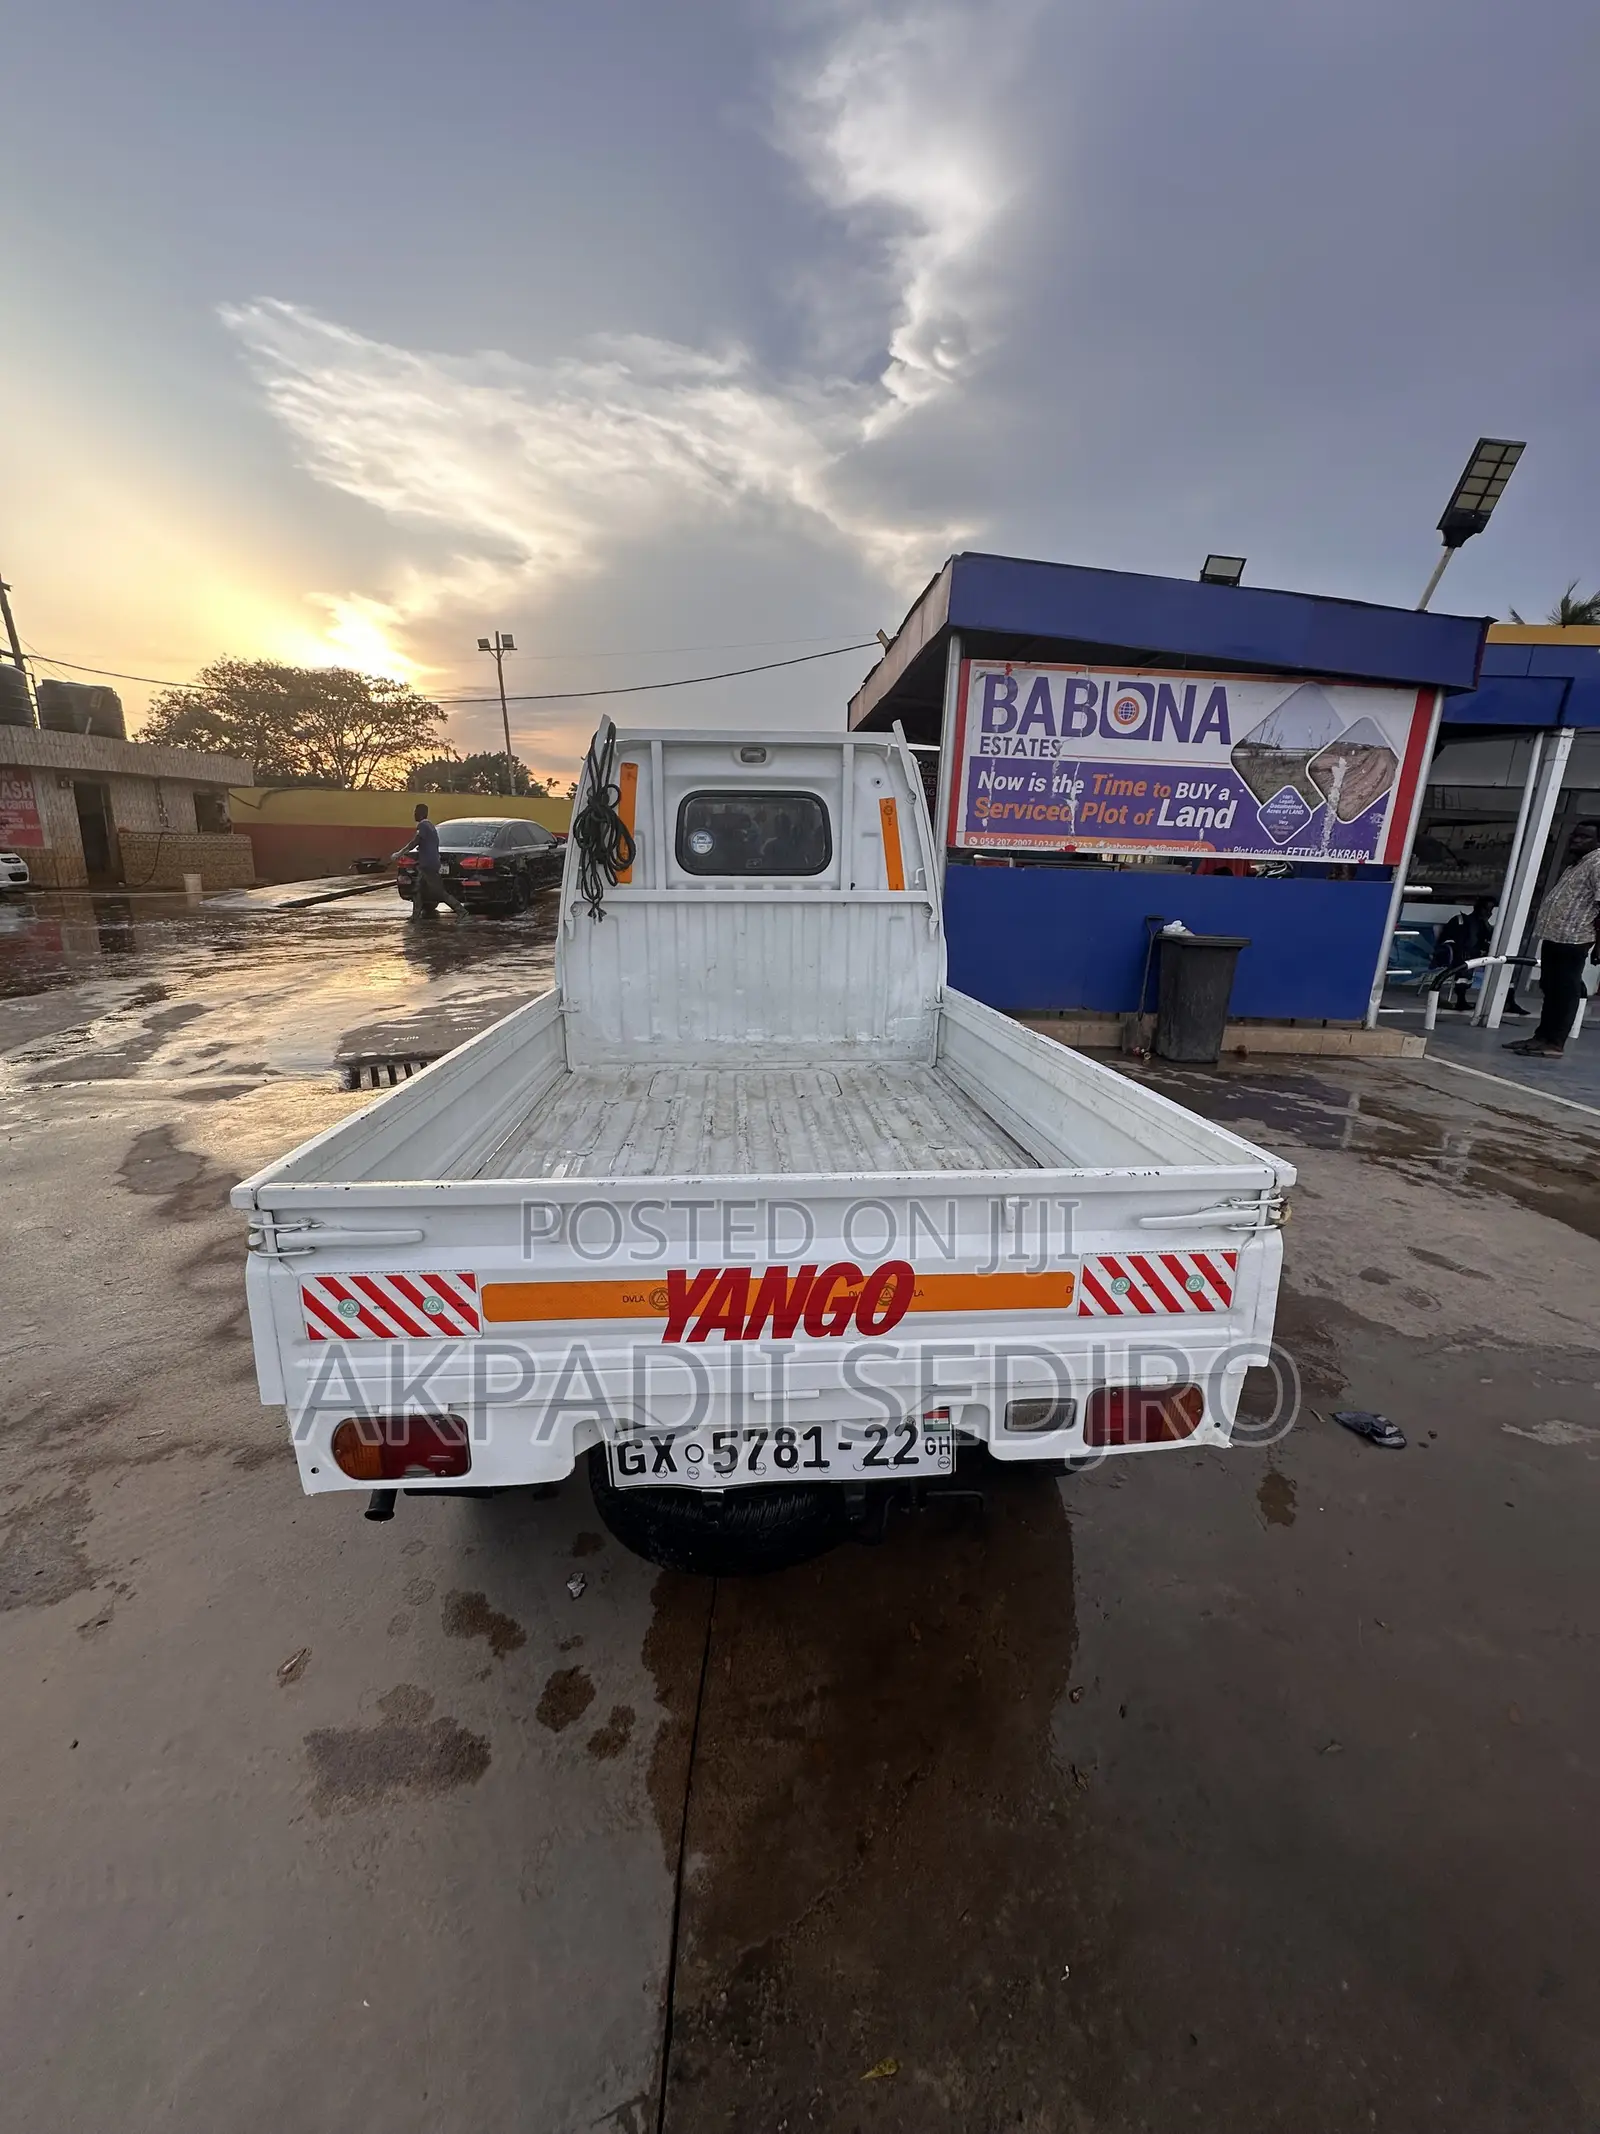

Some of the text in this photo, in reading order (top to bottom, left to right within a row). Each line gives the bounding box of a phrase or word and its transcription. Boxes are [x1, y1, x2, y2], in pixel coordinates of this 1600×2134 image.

[981, 674, 1232, 745] BABONA
[979, 735, 1062, 758] ESTATES
[978, 771, 1230, 801] Now is the Time to BUY a
[1080, 800, 1127, 825] Plot
[1133, 808, 1155, 825] of
[1156, 799, 1238, 829] Land
[622, 1295, 646, 1303] DVLA
[662, 1259, 916, 1344] YANGO
[616, 1433, 678, 1475] GX
[925, 1436, 951, 1456] GH
